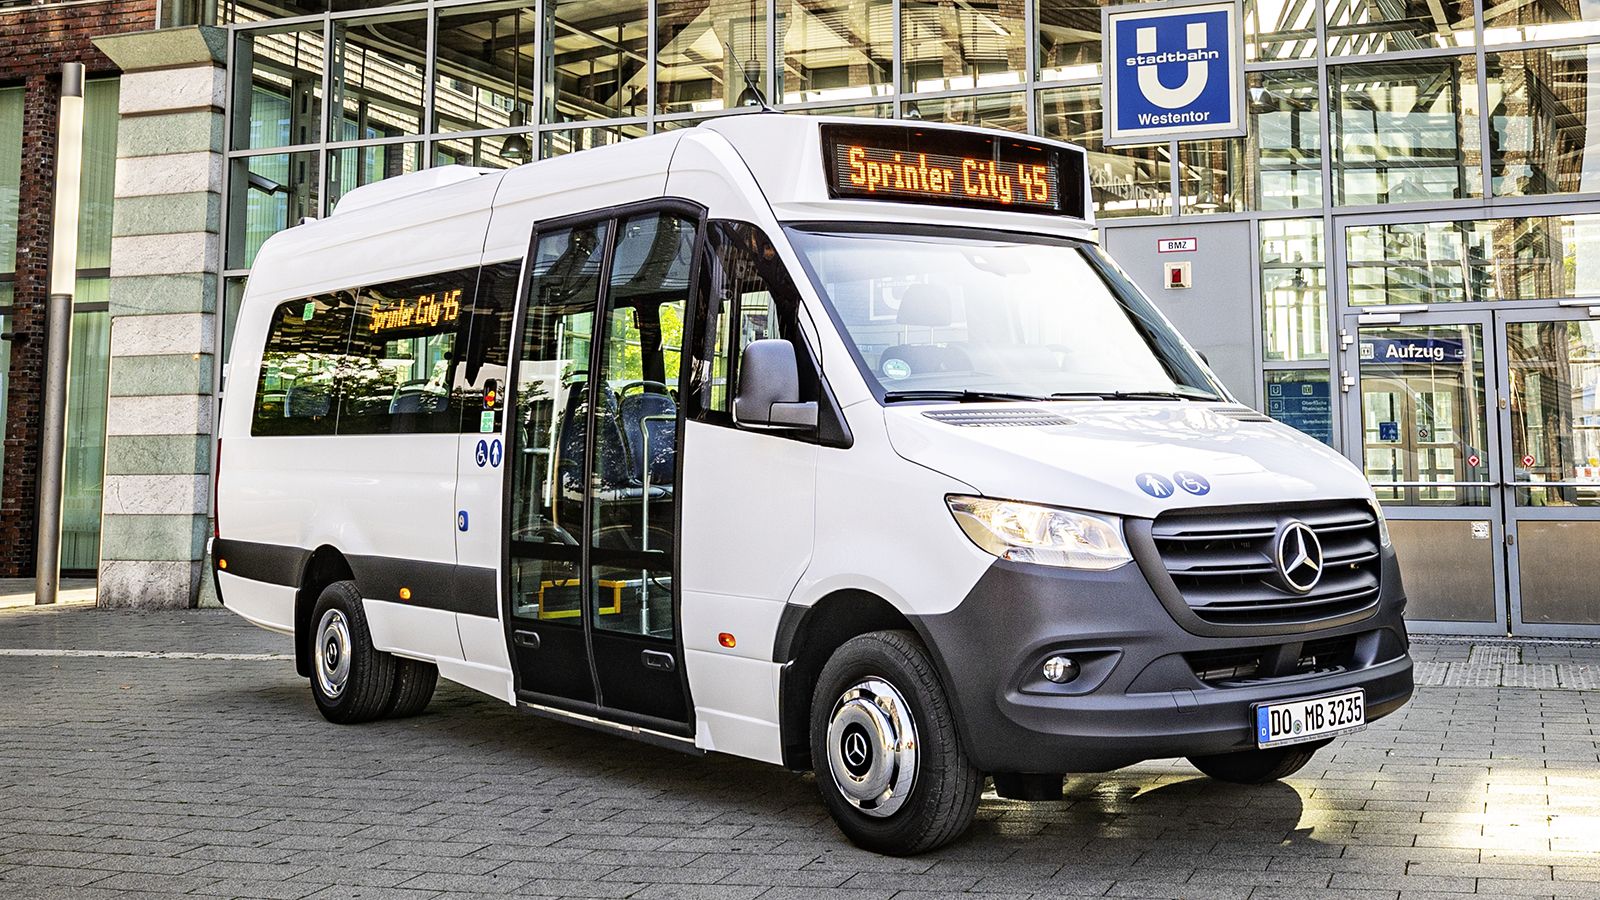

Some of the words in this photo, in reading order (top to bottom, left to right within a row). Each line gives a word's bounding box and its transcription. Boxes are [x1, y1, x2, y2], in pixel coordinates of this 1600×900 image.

[1126, 50, 1219, 66] stadtbahn
[1138, 111, 1210, 125] Westentor
[849, 147, 954, 192] Sprinter
[962, 159, 1012, 203] City
[1018, 165, 1048, 201] 45
[1168, 241, 1187, 250] BMZ
[369, 300, 414, 334] Sprinter
[416, 294, 440, 326] City
[444, 290, 461, 321] 45
[1386, 343, 1444, 361] Aufzug
[1271, 708, 1292, 736] DO
[1305, 704, 1325, 731] MB
[1328, 696, 1362, 726] 3235
